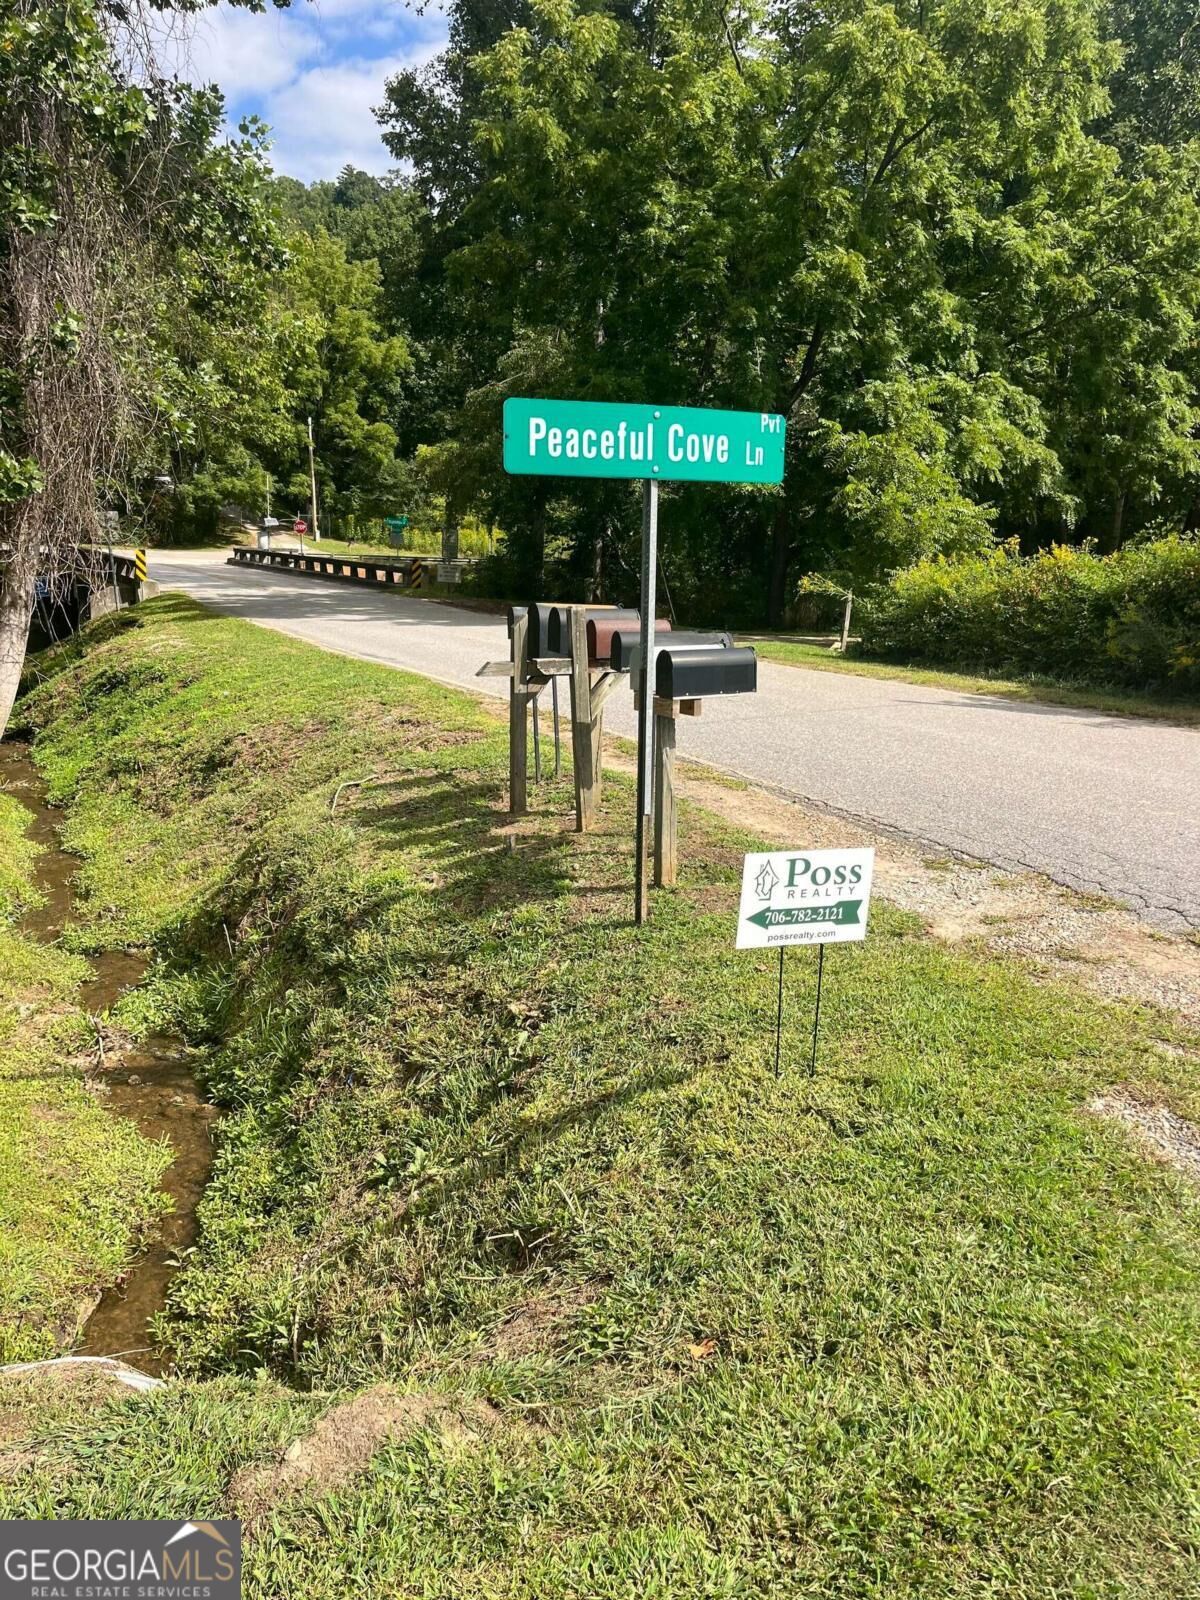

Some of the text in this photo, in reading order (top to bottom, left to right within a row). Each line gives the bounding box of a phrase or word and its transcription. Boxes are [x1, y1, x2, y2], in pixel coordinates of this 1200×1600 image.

[761, 413, 781, 434] Pvt
[528, 417, 764, 466] Peaceful Cove Ln
[787, 886, 856, 899] REALTY
[765, 907, 843, 924] 706-782-2121
[767, 930, 836, 942] possrealty.com
